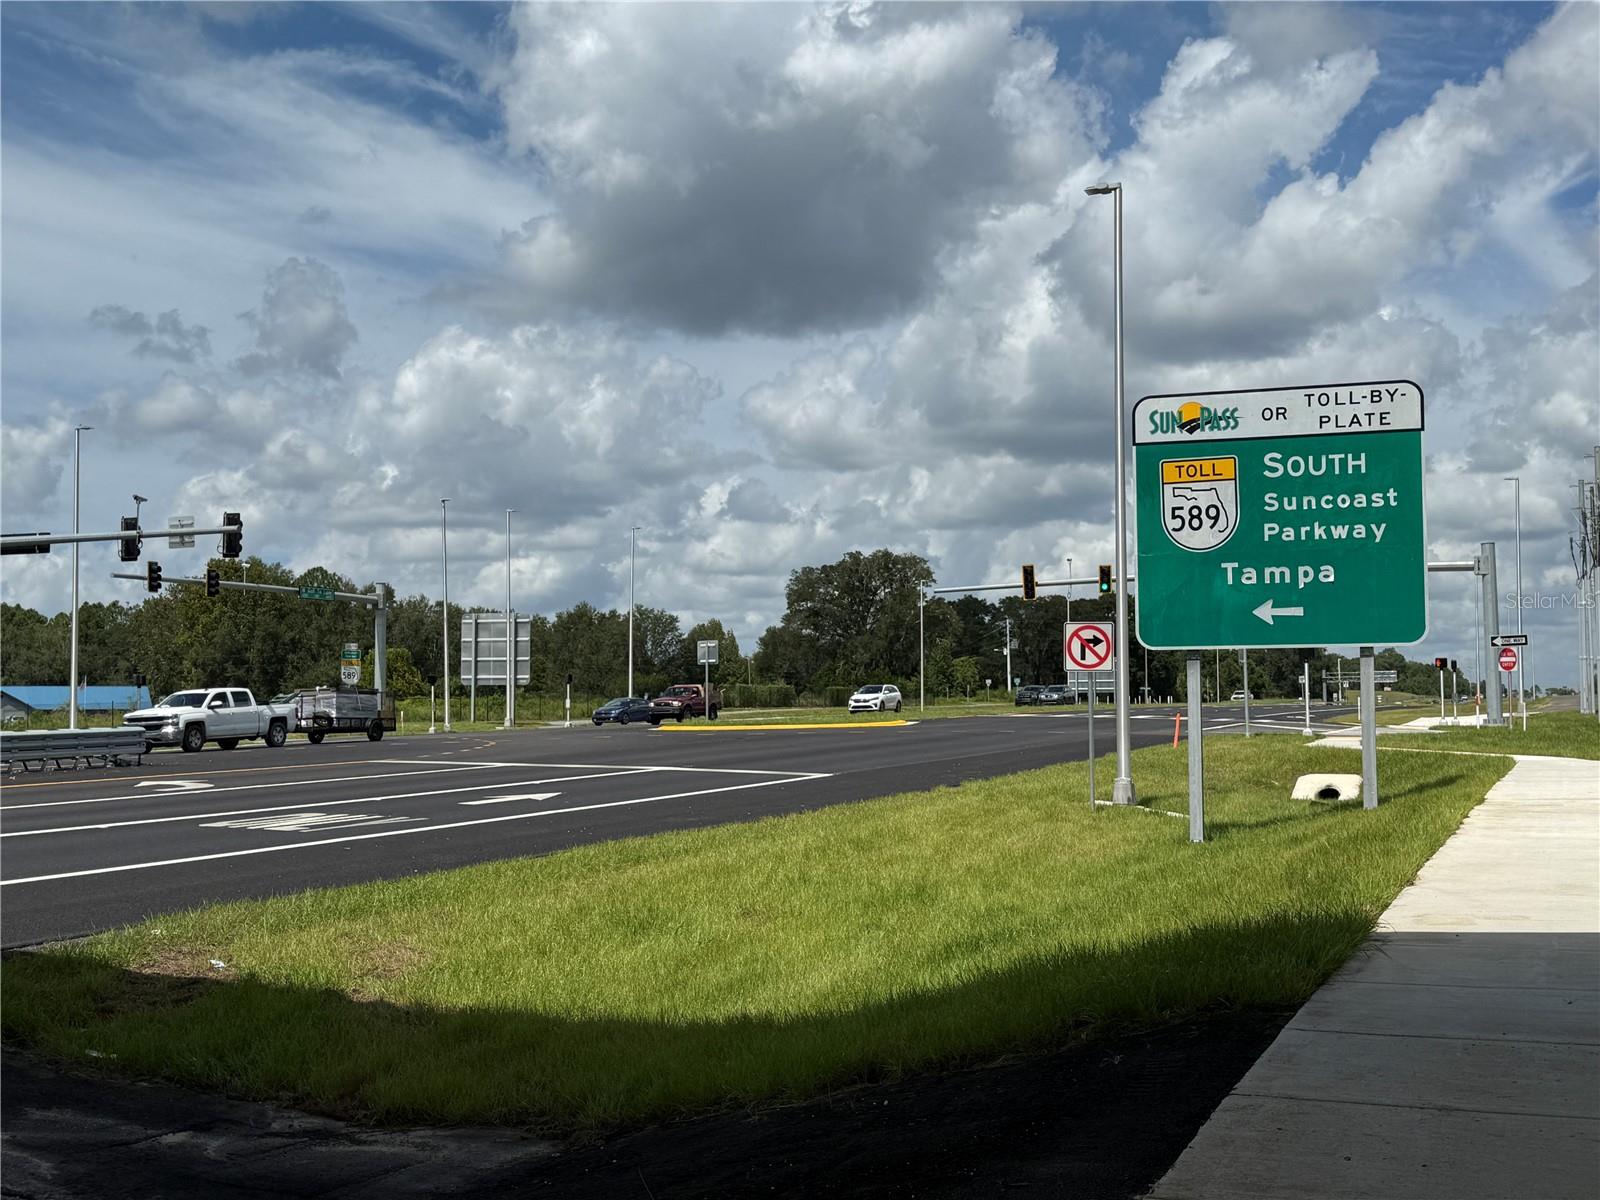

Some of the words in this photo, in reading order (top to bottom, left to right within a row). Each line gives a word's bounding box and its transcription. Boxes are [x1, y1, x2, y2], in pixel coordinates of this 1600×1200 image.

[1304, 388, 1406, 407] TOLL-BY-
[1261, 407, 1287, 421] OR
[1319, 411, 1391, 429] PLATE
[1175, 462, 1223, 479] TOLL
[1263, 452, 1366, 478] SOUTH
[1263, 487, 1398, 511] Suncoast
[1170, 504, 1221, 532] 589
[1263, 522, 1386, 542] Parkway
[1221, 563, 1335, 589] Tampa
